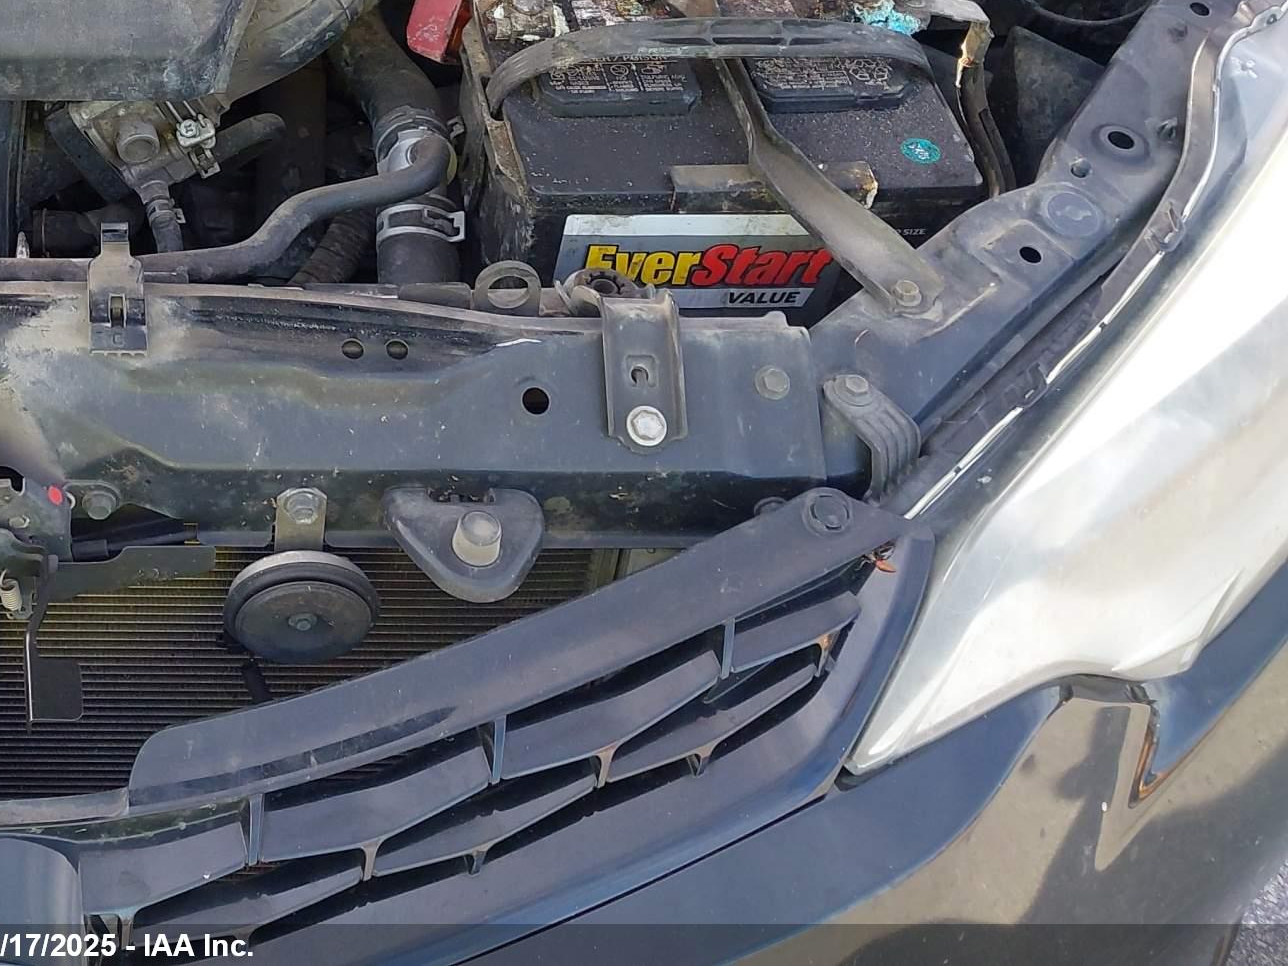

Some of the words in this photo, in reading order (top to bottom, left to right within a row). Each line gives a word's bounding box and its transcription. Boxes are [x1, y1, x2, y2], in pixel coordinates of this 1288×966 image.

[903, 228, 927, 236] SIZE
[583, 243, 834, 287] EverStart
[727, 291, 801, 305] VALUE
